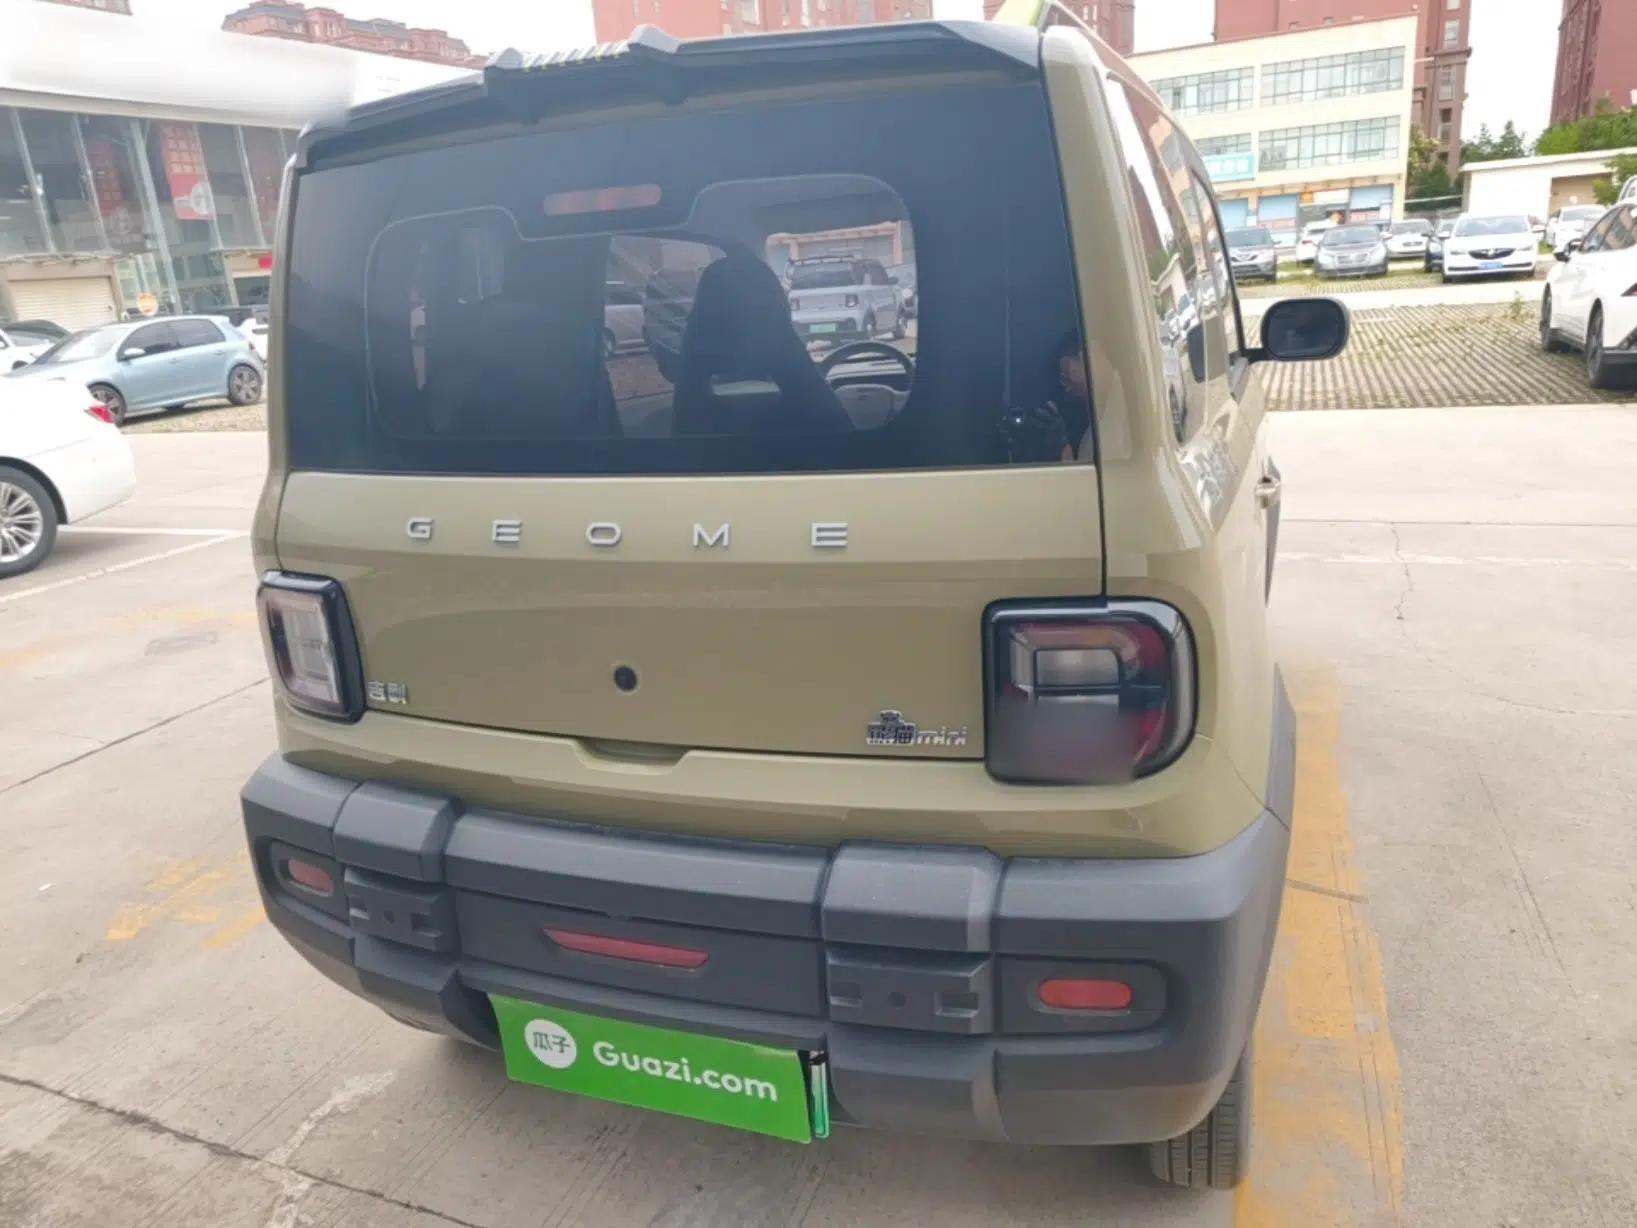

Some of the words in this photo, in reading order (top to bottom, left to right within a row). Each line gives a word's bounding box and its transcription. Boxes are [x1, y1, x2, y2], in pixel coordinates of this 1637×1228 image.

[404, 516, 849, 549] GEOME
[532, 1031, 572, 1054] 瓜子
[592, 1040, 779, 1103] Guazi.com
